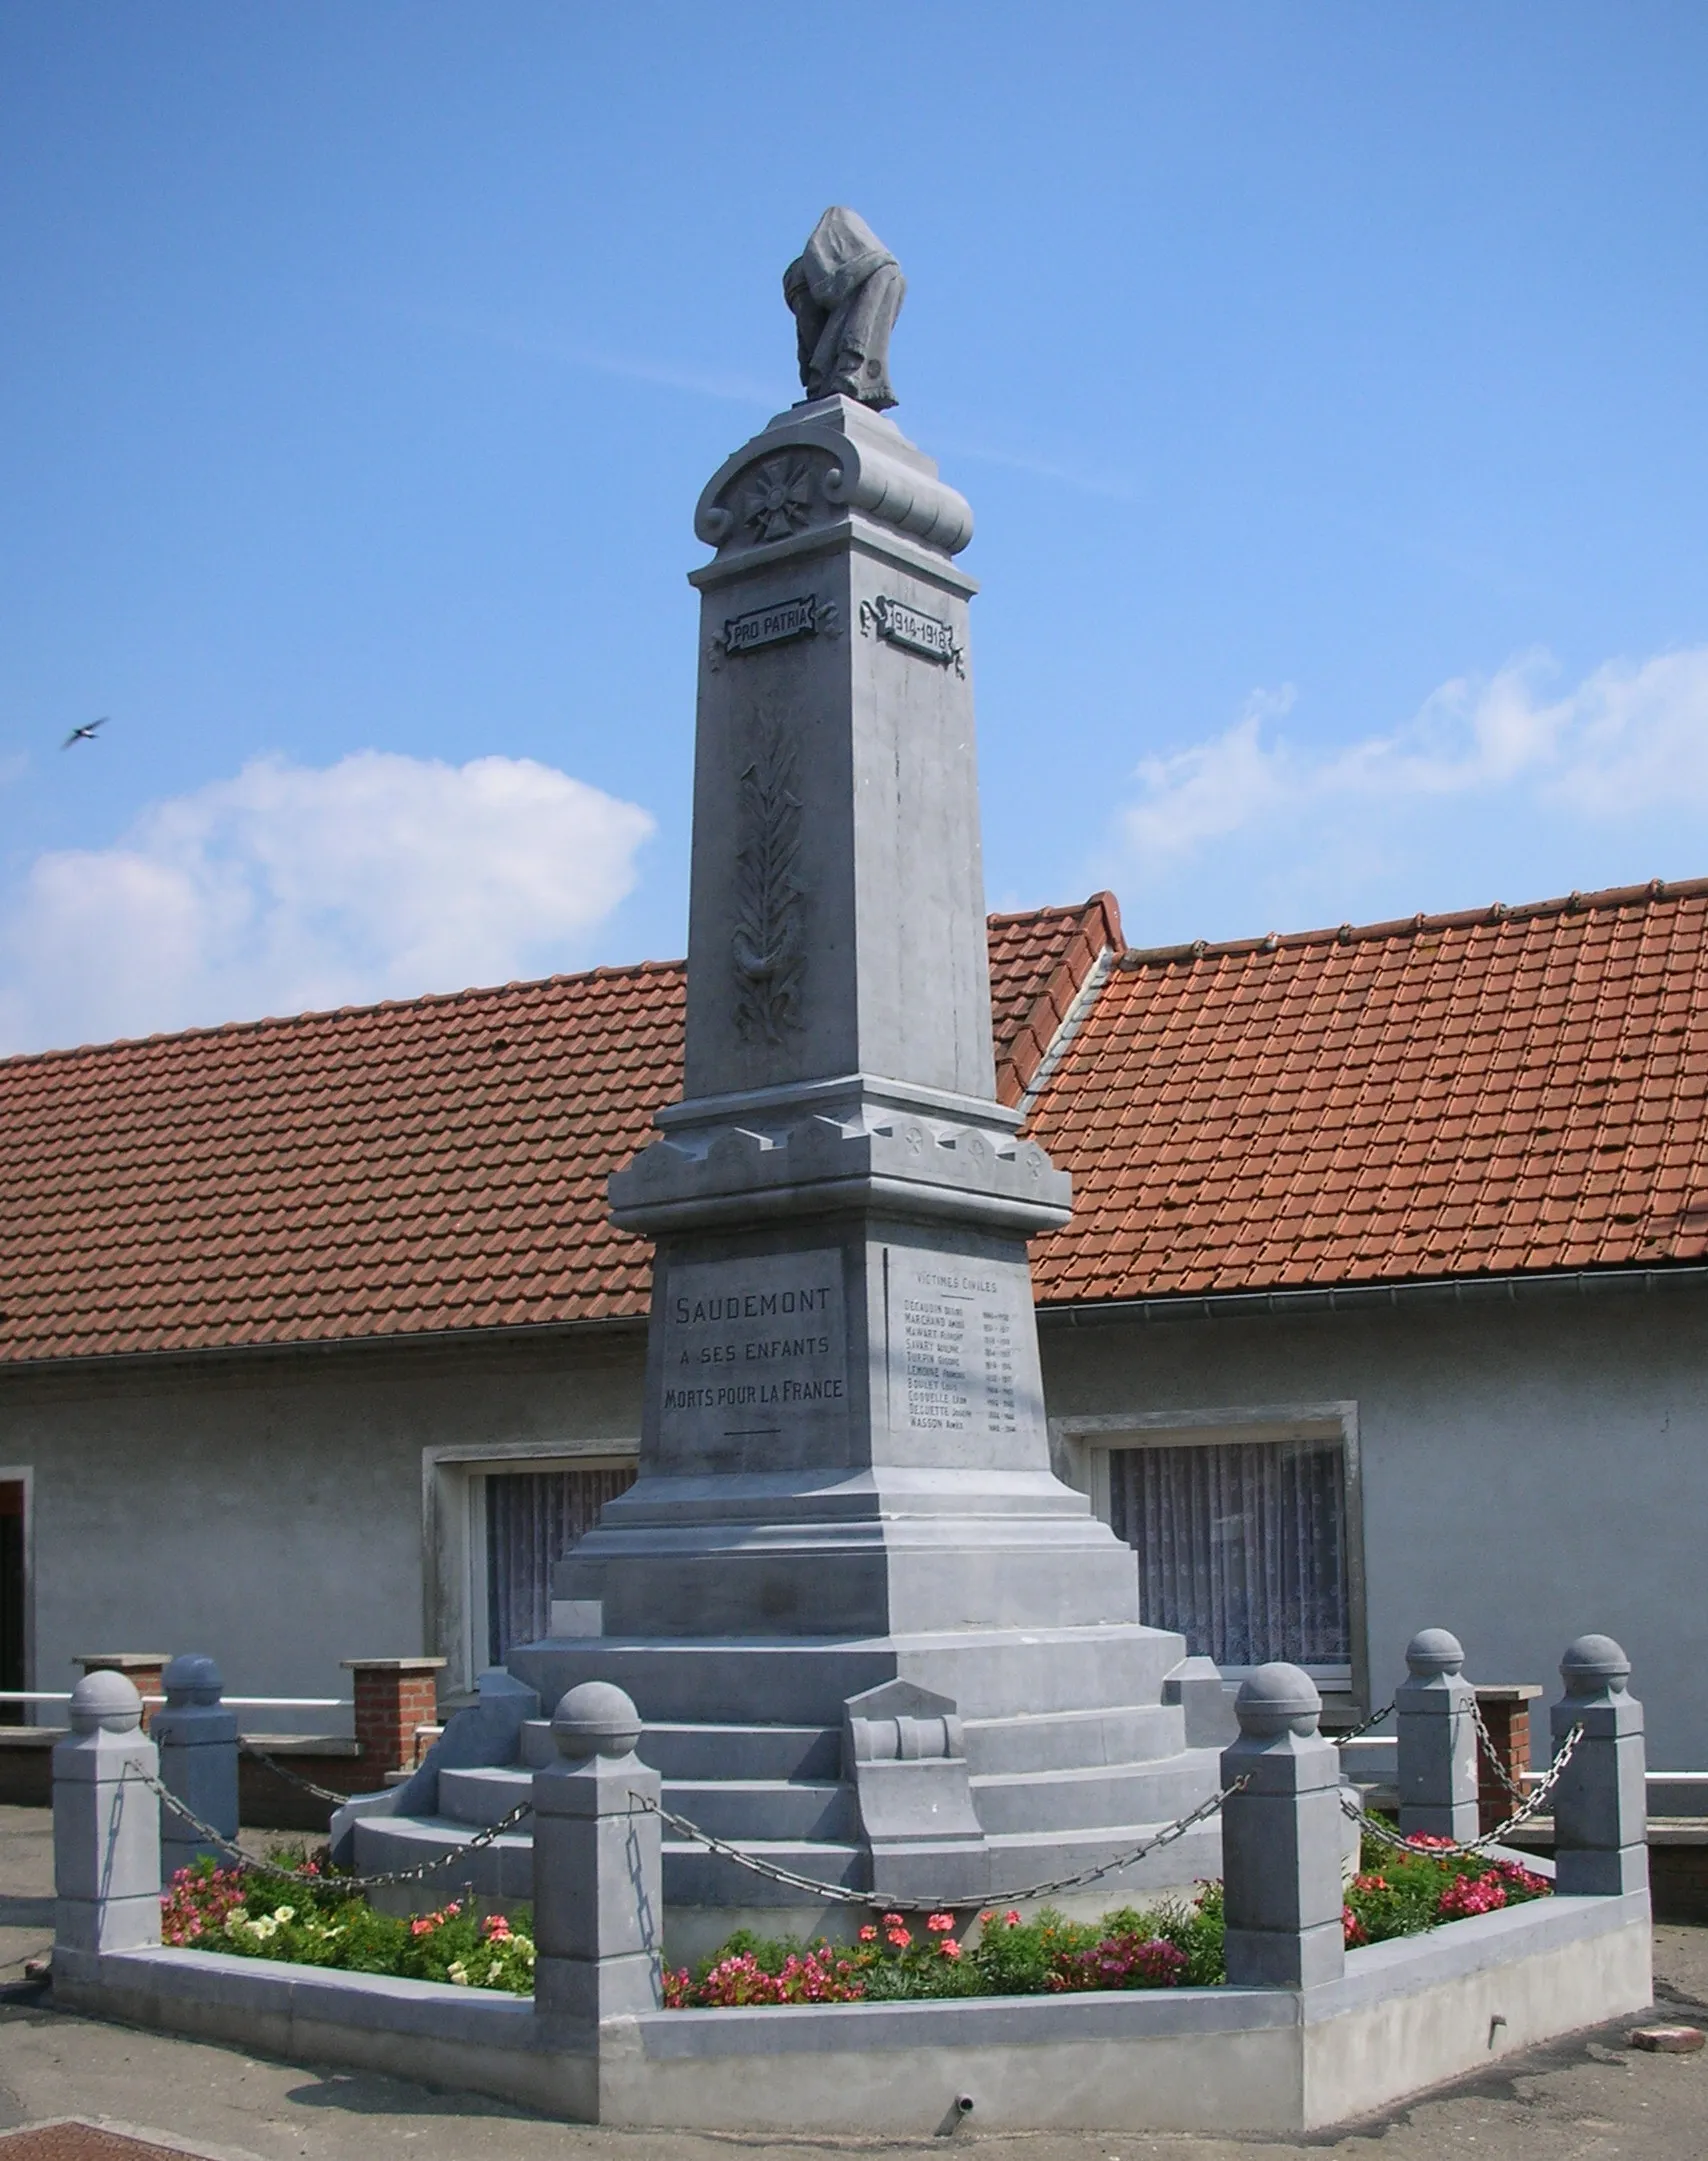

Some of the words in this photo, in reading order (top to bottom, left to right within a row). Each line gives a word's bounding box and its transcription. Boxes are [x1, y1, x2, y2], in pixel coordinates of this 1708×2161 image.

[734, 622, 759, 644] PRO
[764, 609, 808, 635] PATRIA
[890, 610, 948, 649] 1914-1918
[917, 1272, 959, 1289] VICTIMES
[962, 1278, 998, 1293] CIVILES
[675, 1288, 831, 1324] SAUDEMONT
[680, 1351, 690, 1364] A
[700, 1345, 736, 1364] SES
[746, 1337, 830, 1361] ENFANTS
[664, 1388, 714, 1410] MORTS
[718, 1384, 756, 1405] POUR
[761, 1384, 779, 1403] LA
[783, 1379, 843, 1401] FRANCE
